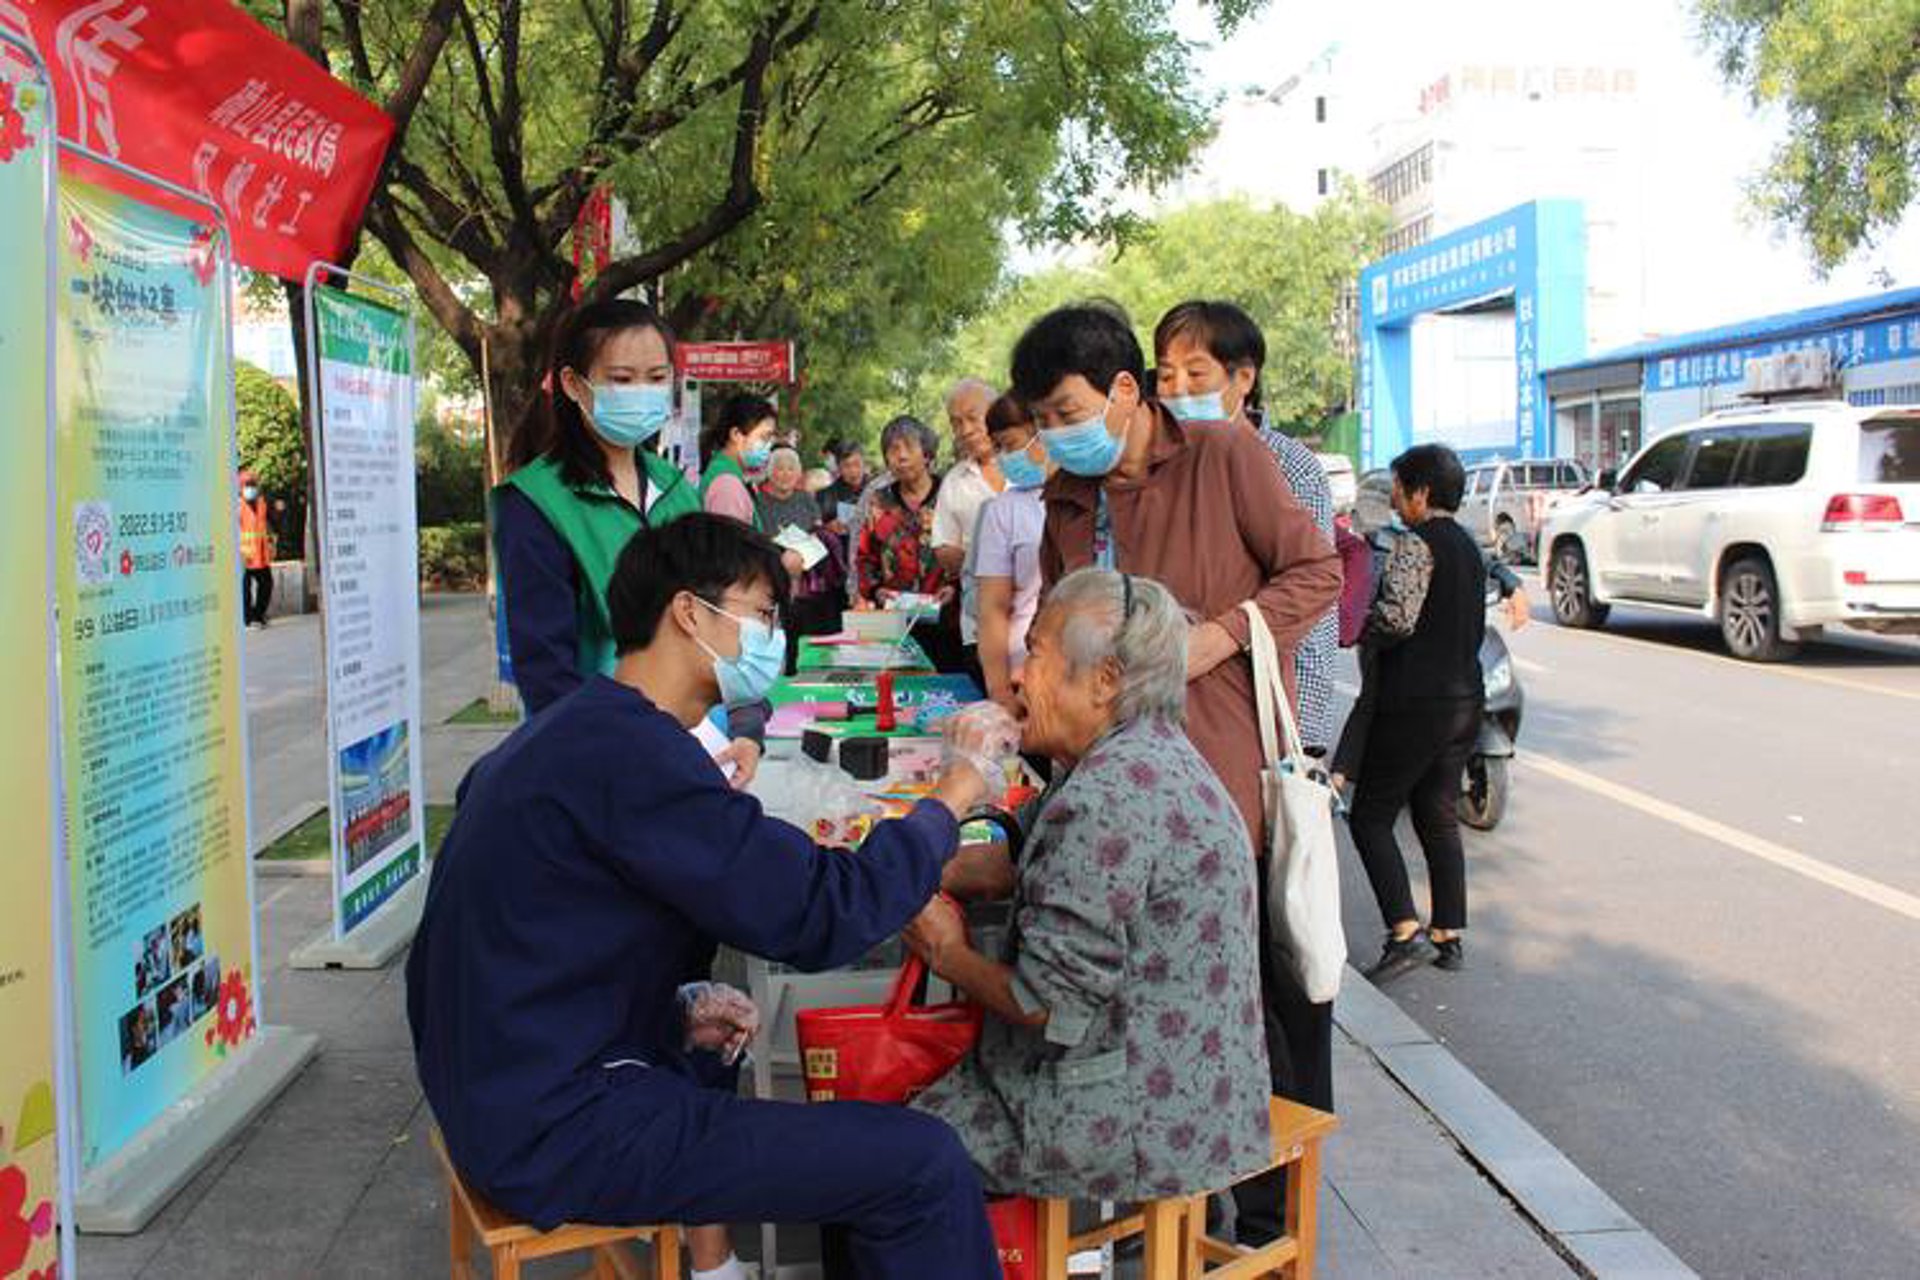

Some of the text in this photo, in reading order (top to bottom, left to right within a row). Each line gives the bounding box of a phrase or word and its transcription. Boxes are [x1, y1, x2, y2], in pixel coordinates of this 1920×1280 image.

[207, 78, 345, 179] 确山县民政局
